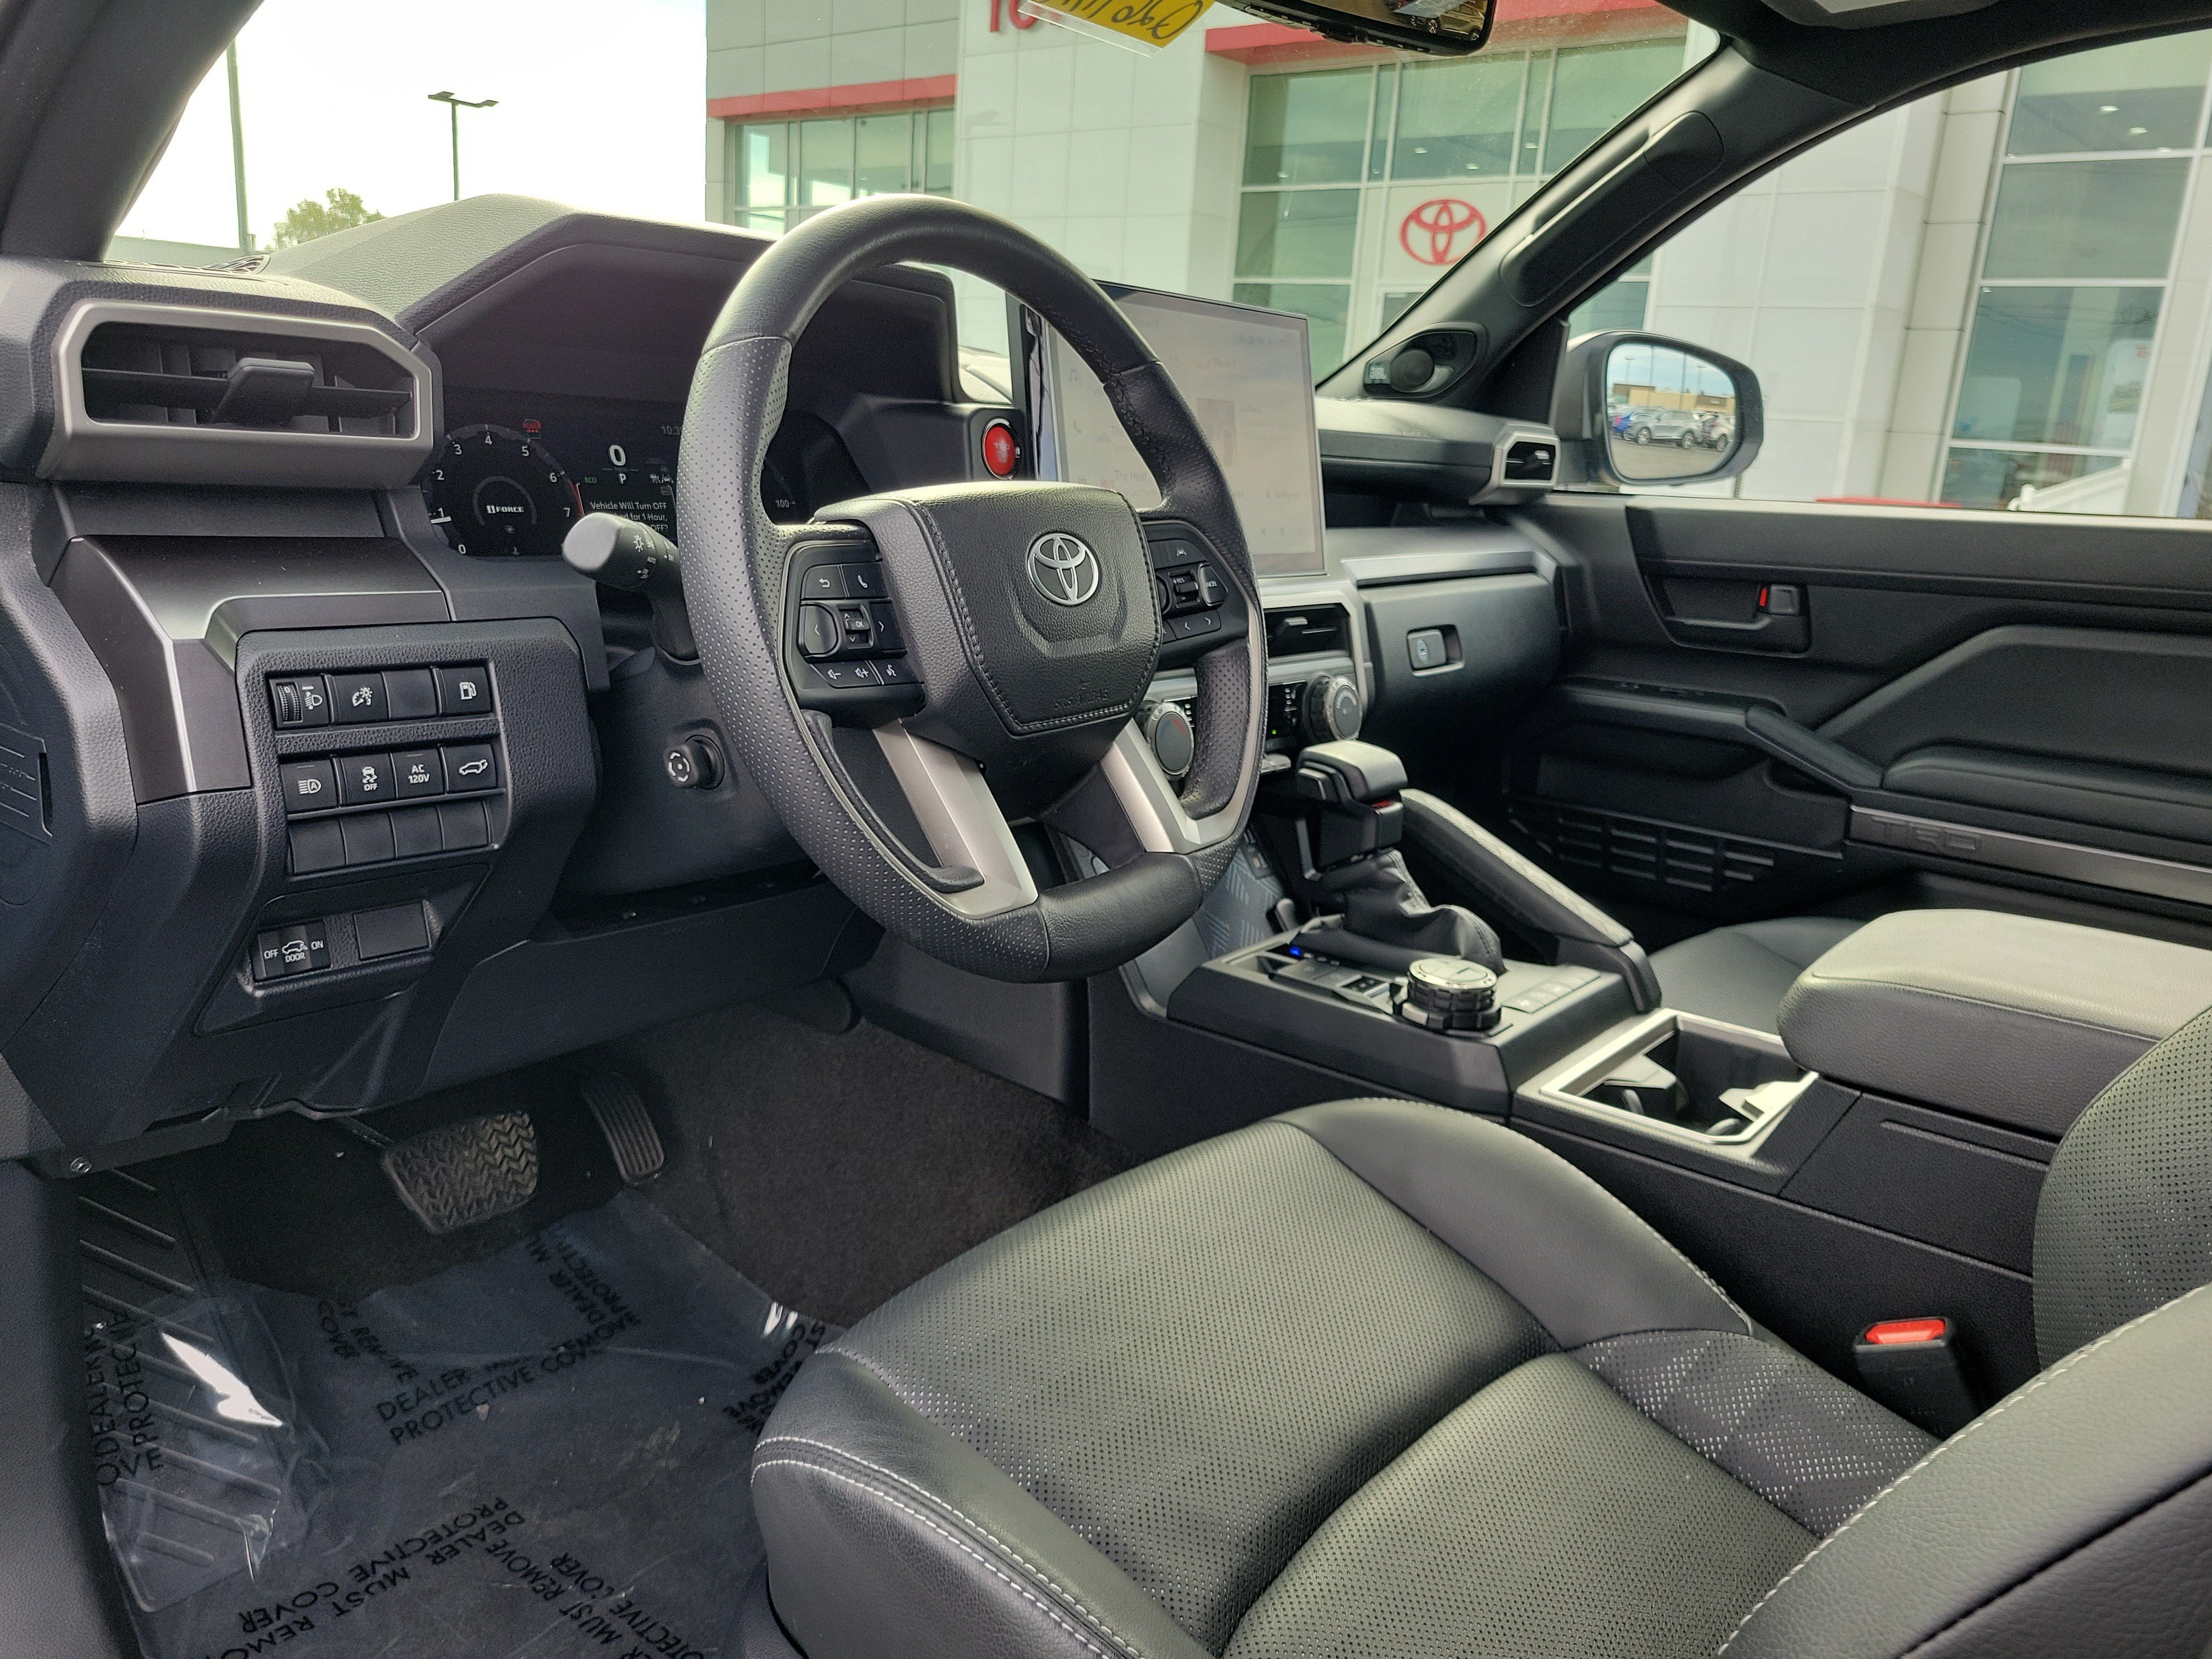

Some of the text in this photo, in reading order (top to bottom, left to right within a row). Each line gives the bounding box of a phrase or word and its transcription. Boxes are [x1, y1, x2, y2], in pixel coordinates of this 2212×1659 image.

[484, 435, 493, 446] 4
[454, 443, 462, 455] 3
[521, 445, 530, 456] 5
[608, 445, 627, 466] 0
[435, 470, 445, 481] 2
[549, 472, 558, 483] 6
[618, 473, 627, 484] P
[590, 501, 667, 510] Vehicle Will Turn OFF
[775, 500, 789, 508] 100
[438, 507, 444, 518] 1
[563, 507, 571, 518] 7
[647, 514, 668, 522] Hour,
[458, 544, 466, 555] 0
[855, 620, 864, 629] OK
[411, 764, 425, 774] AC
[408, 774, 430, 785] 120V
[364, 783, 379, 792] OFF
[1871, 815, 1982, 854] TRD
[311, 940, 324, 950] ON
[263, 949, 279, 960] OFF
[285, 952, 306, 963] DOOR
[376, 1367, 474, 1422] DEALER
[390, 1365, 535, 1446] PROTECTIVE
[238, 1496, 510, 1634] PROTECTIVE COVER
[203, 1510, 527, 1659] DEALER MUST REMO
[485, 1538, 623, 1645] MUST REMOVE
[551, 1551, 704, 1659] TECTIVE COVER
